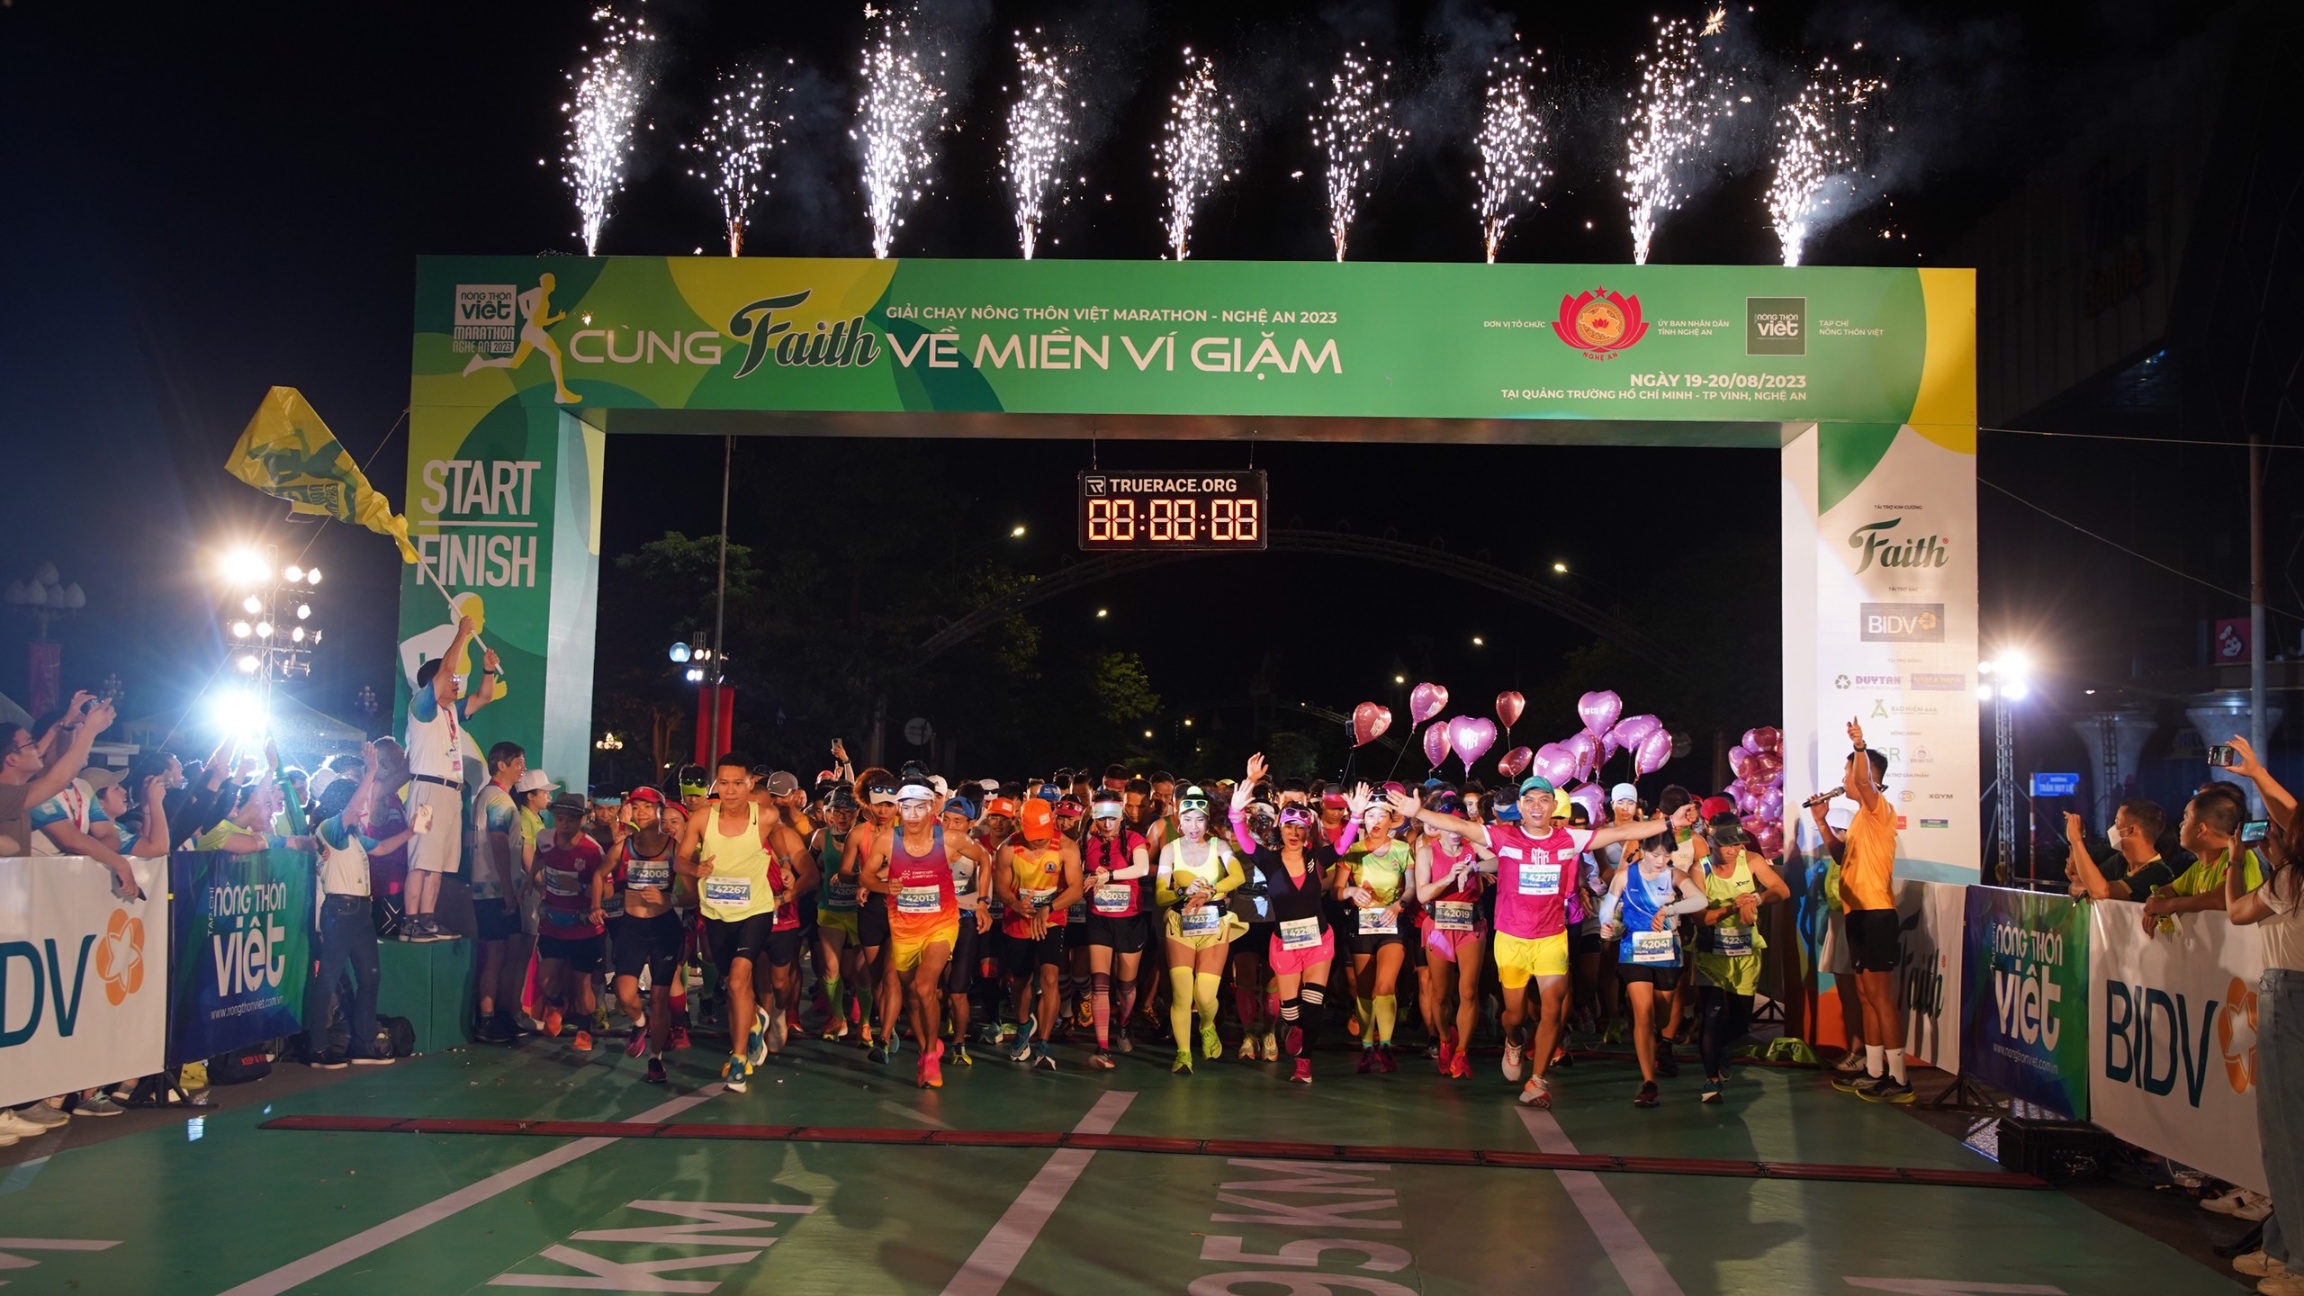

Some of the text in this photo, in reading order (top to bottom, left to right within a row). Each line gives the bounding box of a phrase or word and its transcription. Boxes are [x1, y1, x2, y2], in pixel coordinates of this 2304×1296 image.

[461, 291, 512, 300] NÔNG THÔN
[886, 303, 919, 319] GIẢI
[922, 306, 967, 321] CHẠY
[971, 305, 1019, 320] NÔNG
[1023, 305, 1069, 320] THÔN
[1073, 305, 1109, 323] VIỆT
[1113, 309, 1207, 322] MARATHON
[1222, 308, 1267, 326] NGHỆ
[1272, 311, 1295, 323] AN
[1300, 311, 1338, 324] 2023
[1757, 312, 1777, 321] NÔNG
[1779, 312, 1799, 321] THÔN
[1483, 319, 1502, 328] ĐƠN
[1524, 319, 1546, 328] CHỨC
[1670, 319, 1687, 328] BAN
[1688, 319, 1711, 328] NHÂN
[1712, 319, 1730, 328] DÂN
[1835, 318, 1849, 327] CHÍ
[454, 326, 514, 340] MARATHON
[569, 288, 1343, 381] CÙNG Faith VỀ MIỀN VÍ GIẶM
[1677, 327, 1700, 337] NGHỆ
[1701, 328, 1713, 336] AN
[1819, 327, 1842, 336] NÔNG
[1843, 327, 1866, 336] THÔN
[478, 341, 490, 353] AN
[494, 342, 512, 352] 2023
[1582, 351, 1618, 362] NGHỆ AN
[1630, 371, 1807, 390] NGÀY 19-20/08/2023
[1501, 389, 1519, 400] TẠI
[1522, 387, 1565, 401] QUẢNG
[1567, 387, 1616, 400] TRƯỜNG
[1618, 387, 1638, 400] HỒ
[1639, 388, 1660, 400] CHÍ
[1662, 391, 1692, 400] MINH
[1702, 391, 1717, 400] TP
[1719, 391, 1751, 402] VINH,
[1755, 389, 1787, 402] NGHỆ
[1789, 392, 1807, 401] AN
[421, 459, 542, 515] START
[1110, 478, 1238, 493] TRUERACE.ORG
[1848, 517, 1949, 576] Faith
[416, 534, 537, 587] FINISH
[1868, 615, 1918, 634] BIDV
[636, 868, 669, 878] 42008
[1527, 873, 1558, 882] 42278
[715, 885, 748, 895] 42267
[213, 878, 286, 917] NÔNG THÔN
[905, 893, 936, 903] 42013
[1443, 908, 1470, 918] 42019
[1641, 939, 1670, 949] 42041
[1996, 920, 2063, 966] NÔNG THÔN
[2106, 979, 2219, 1108] BIDV
